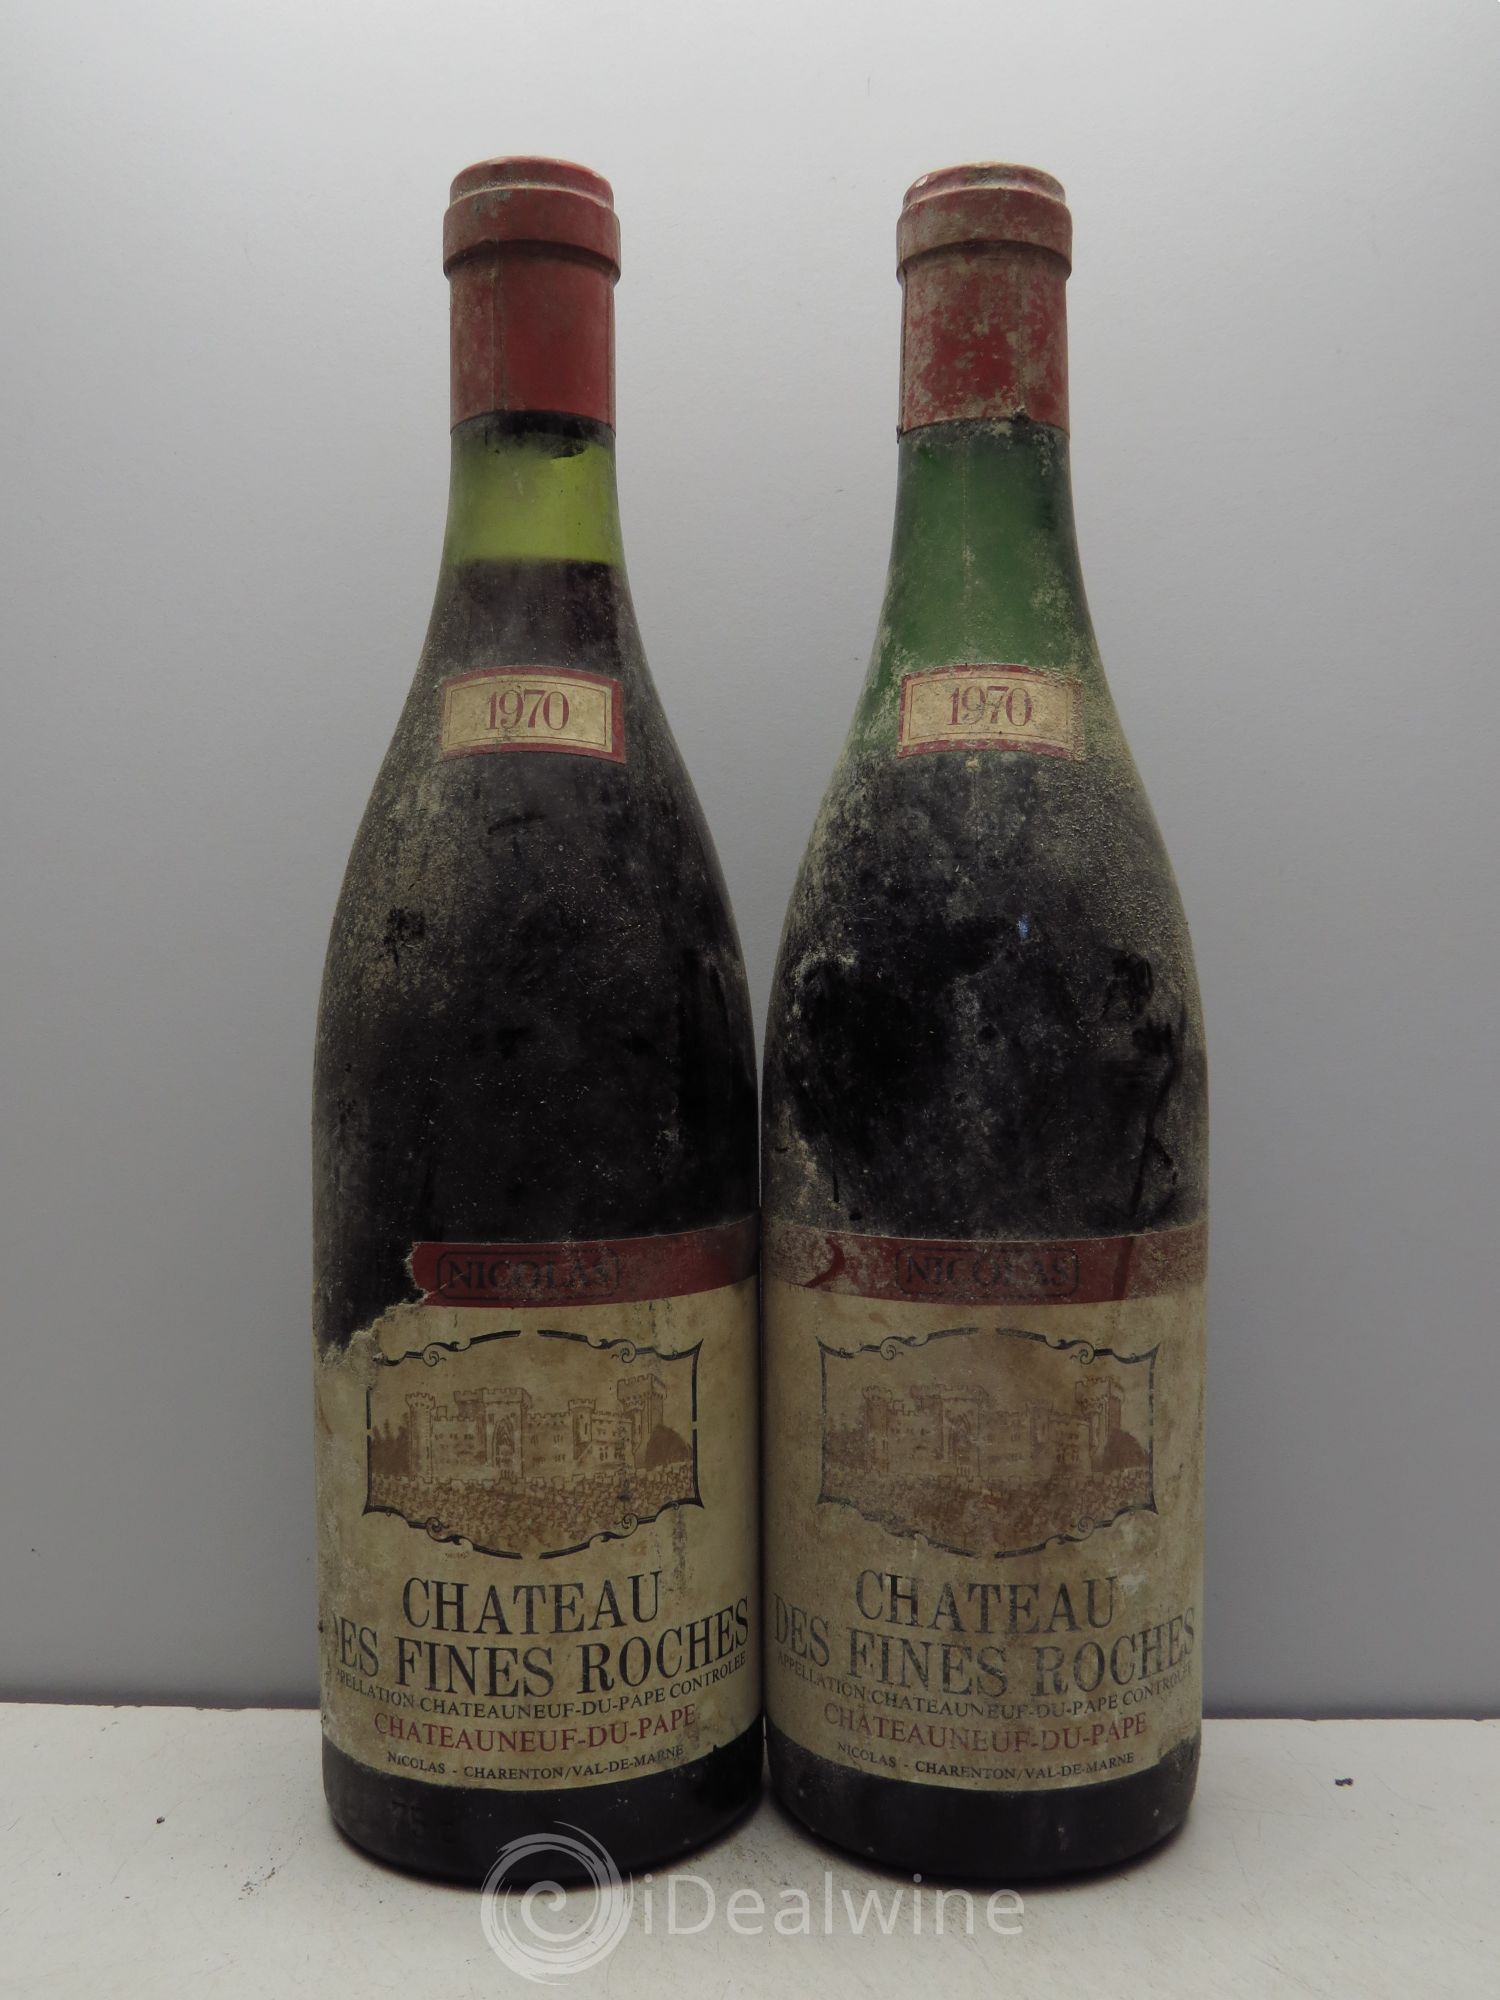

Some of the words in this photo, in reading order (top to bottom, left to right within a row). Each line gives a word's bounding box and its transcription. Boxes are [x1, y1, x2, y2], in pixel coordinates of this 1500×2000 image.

[485, 688, 570, 731] 1970
[947, 685, 1033, 729] 1970
[448, 1258, 610, 1290] NICOLAS
[402, 1571, 663, 1635] CHATEAU
[856, 1568, 1119, 1634] CHATEAU
[395, 1635, 554, 1698] FINES
[577, 1596, 749, 1696] ROCHES
[774, 1592, 831, 1669] DES
[846, 1626, 1008, 1698] FINES
[1031, 1606, 1196, 1697] ROCHES
[420, 1686, 666, 1720] CHATEAUNEUF-DU-PAPE
[669, 1650, 747, 1699] CONTROLEE
[777, 1650, 868, 1702] APPELLATION
[872, 1689, 1119, 1720] CHATEAUNEUF-DU-PAPE
[374, 1703, 696, 1753] CHATEAUNEUF-DU-PAPE
[823, 1702, 1147, 1753] CHATEAUNEUF-DU-PAPE
[387, 1751, 446, 1775] NICOLAS
[837, 1741, 897, 1769] NICOLAS
